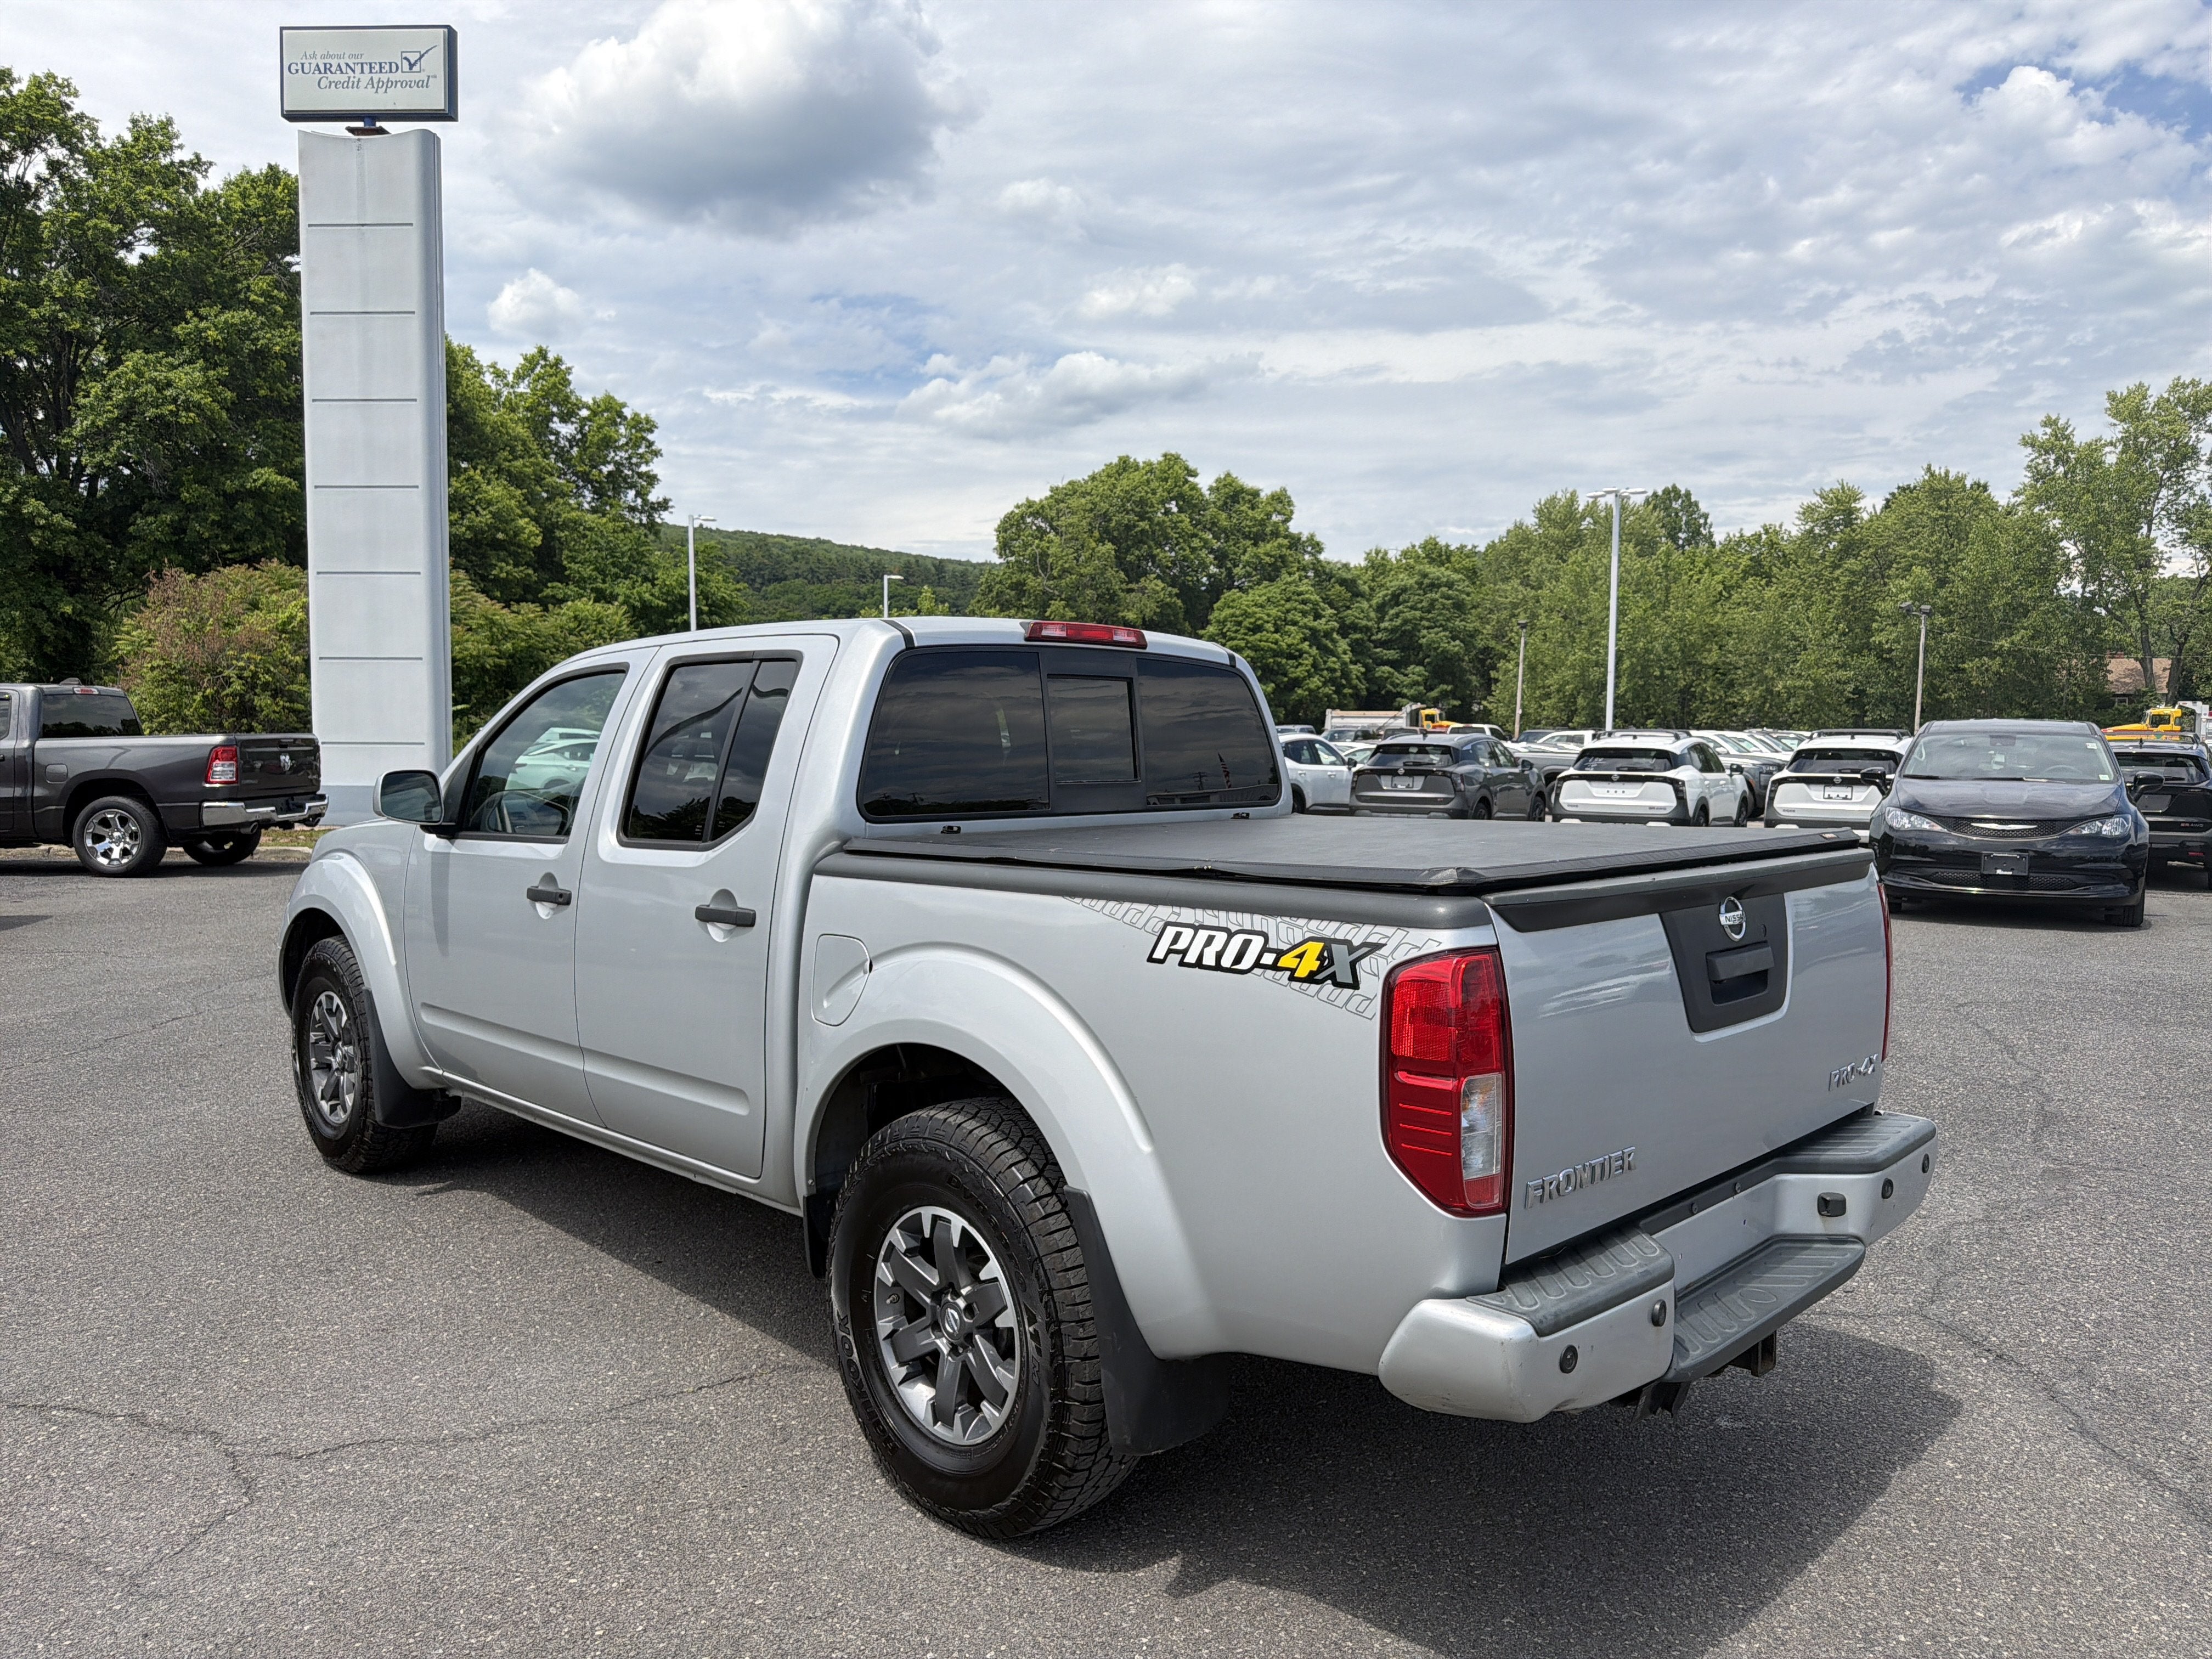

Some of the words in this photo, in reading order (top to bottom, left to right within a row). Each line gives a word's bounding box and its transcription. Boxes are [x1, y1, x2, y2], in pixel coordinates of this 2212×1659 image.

[287, 61, 399, 75] GUARANTEED
[301, 51, 317, 60] Ask
[320, 50, 346, 60] about
[348, 52, 364, 60] our
[317, 75, 361, 90] Credit
[364, 75, 431, 94] Approval
[1147, 922, 1386, 990] PRO-4X
[1827, 1053, 1878, 1092] PRO-4X
[1524, 1146, 1637, 1209] FRONTIER
